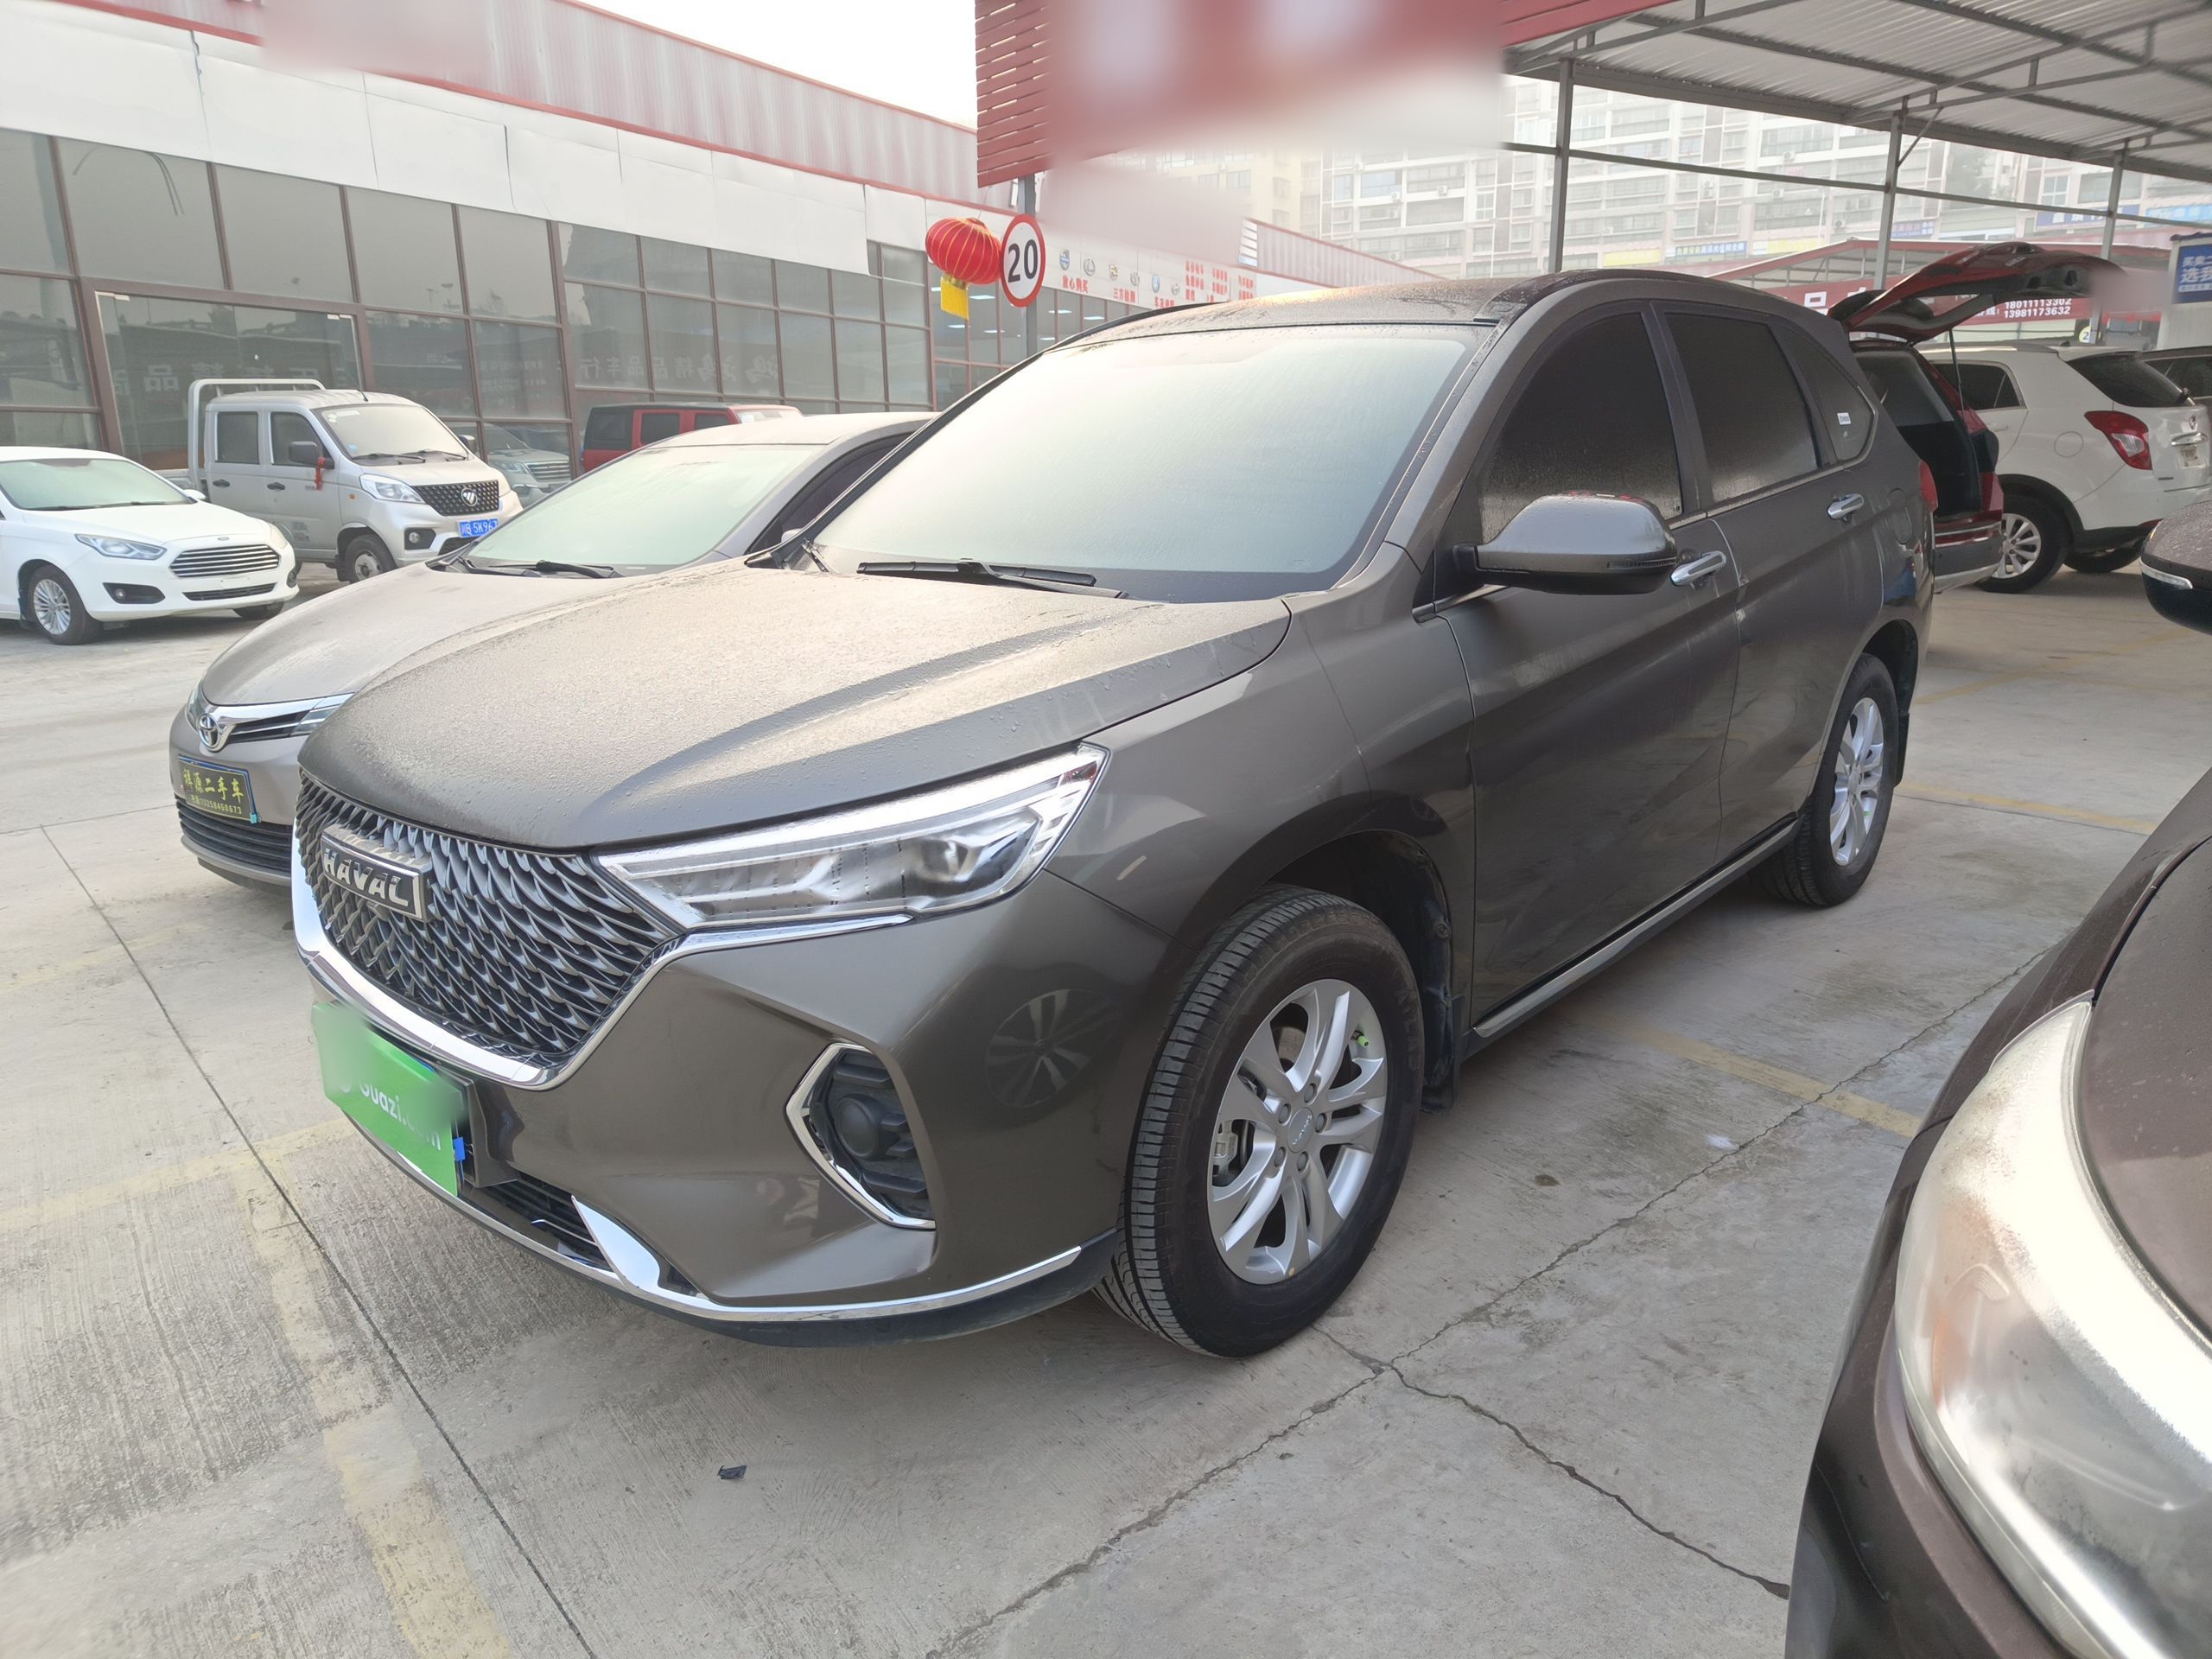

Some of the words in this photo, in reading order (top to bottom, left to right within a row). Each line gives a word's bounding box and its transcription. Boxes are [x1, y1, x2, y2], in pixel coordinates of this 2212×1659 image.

[1007, 238, 1039, 283] 20
[2004, 305, 2071, 318] 13981173632
[323, 848, 409, 907] HAVAL
